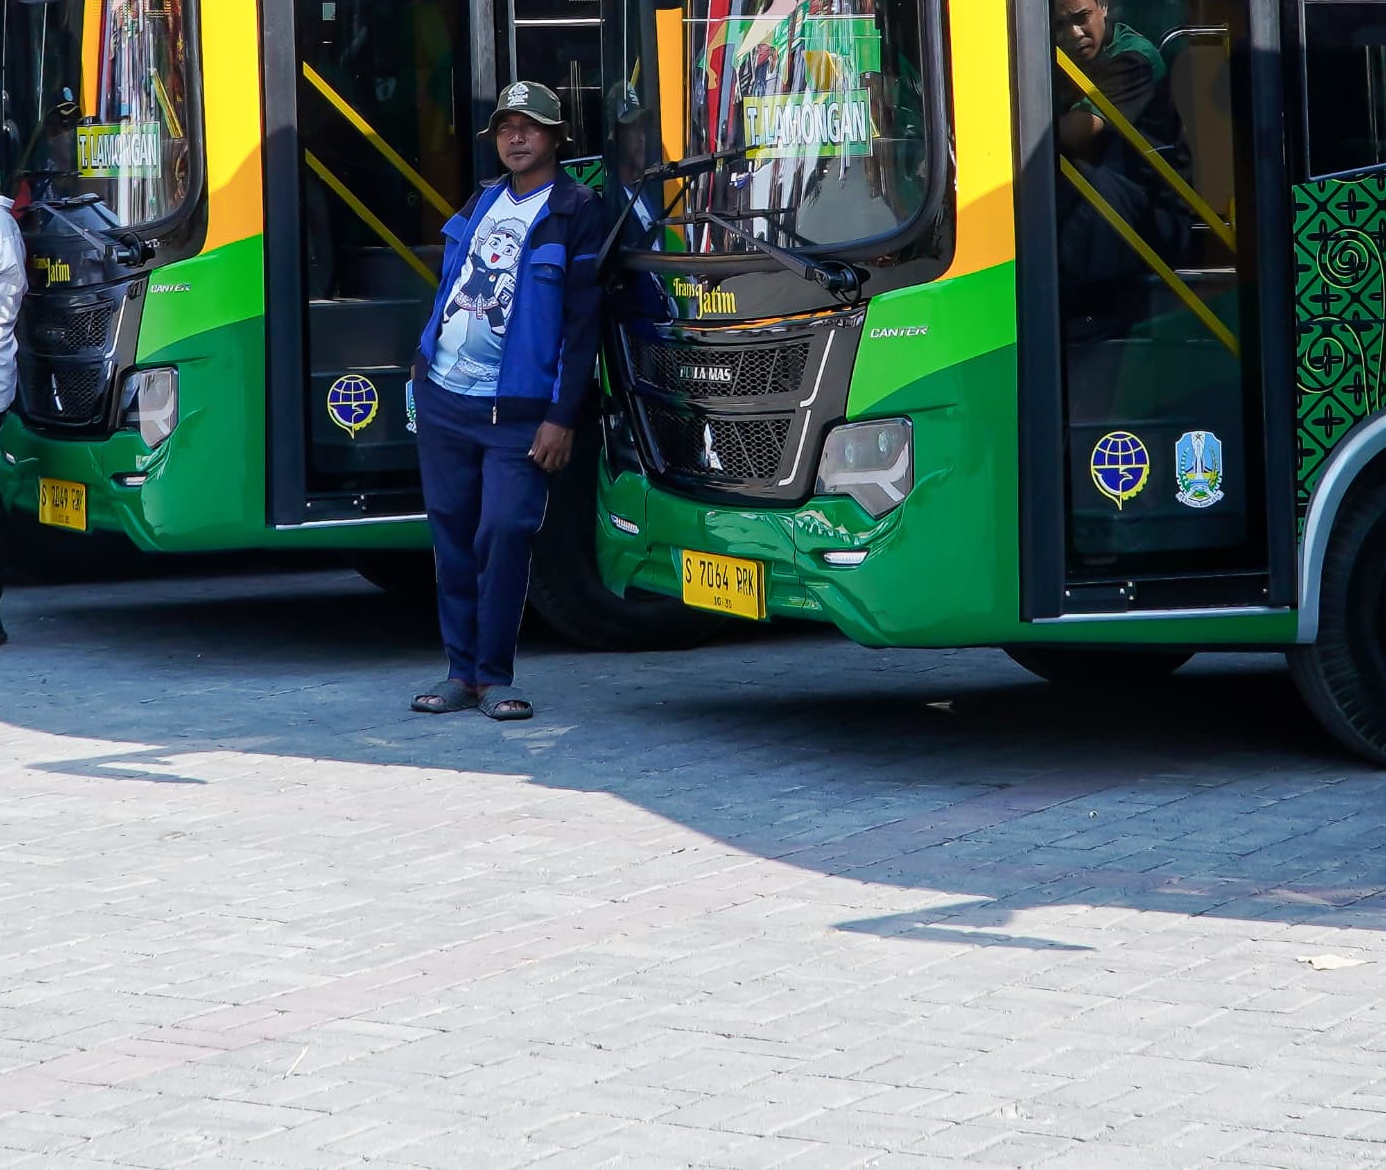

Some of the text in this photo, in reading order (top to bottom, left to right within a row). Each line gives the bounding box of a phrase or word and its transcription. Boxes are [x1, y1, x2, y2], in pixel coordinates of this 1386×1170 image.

[747, 101, 867, 147] T. LAMONGAN
[673, 278, 695, 298] Trans
[695, 283, 737, 319] Jatim
[870, 325, 929, 338] CANTER
[708, 367, 732, 381] MAS
[685, 558, 755, 597] S 7064 PRK
